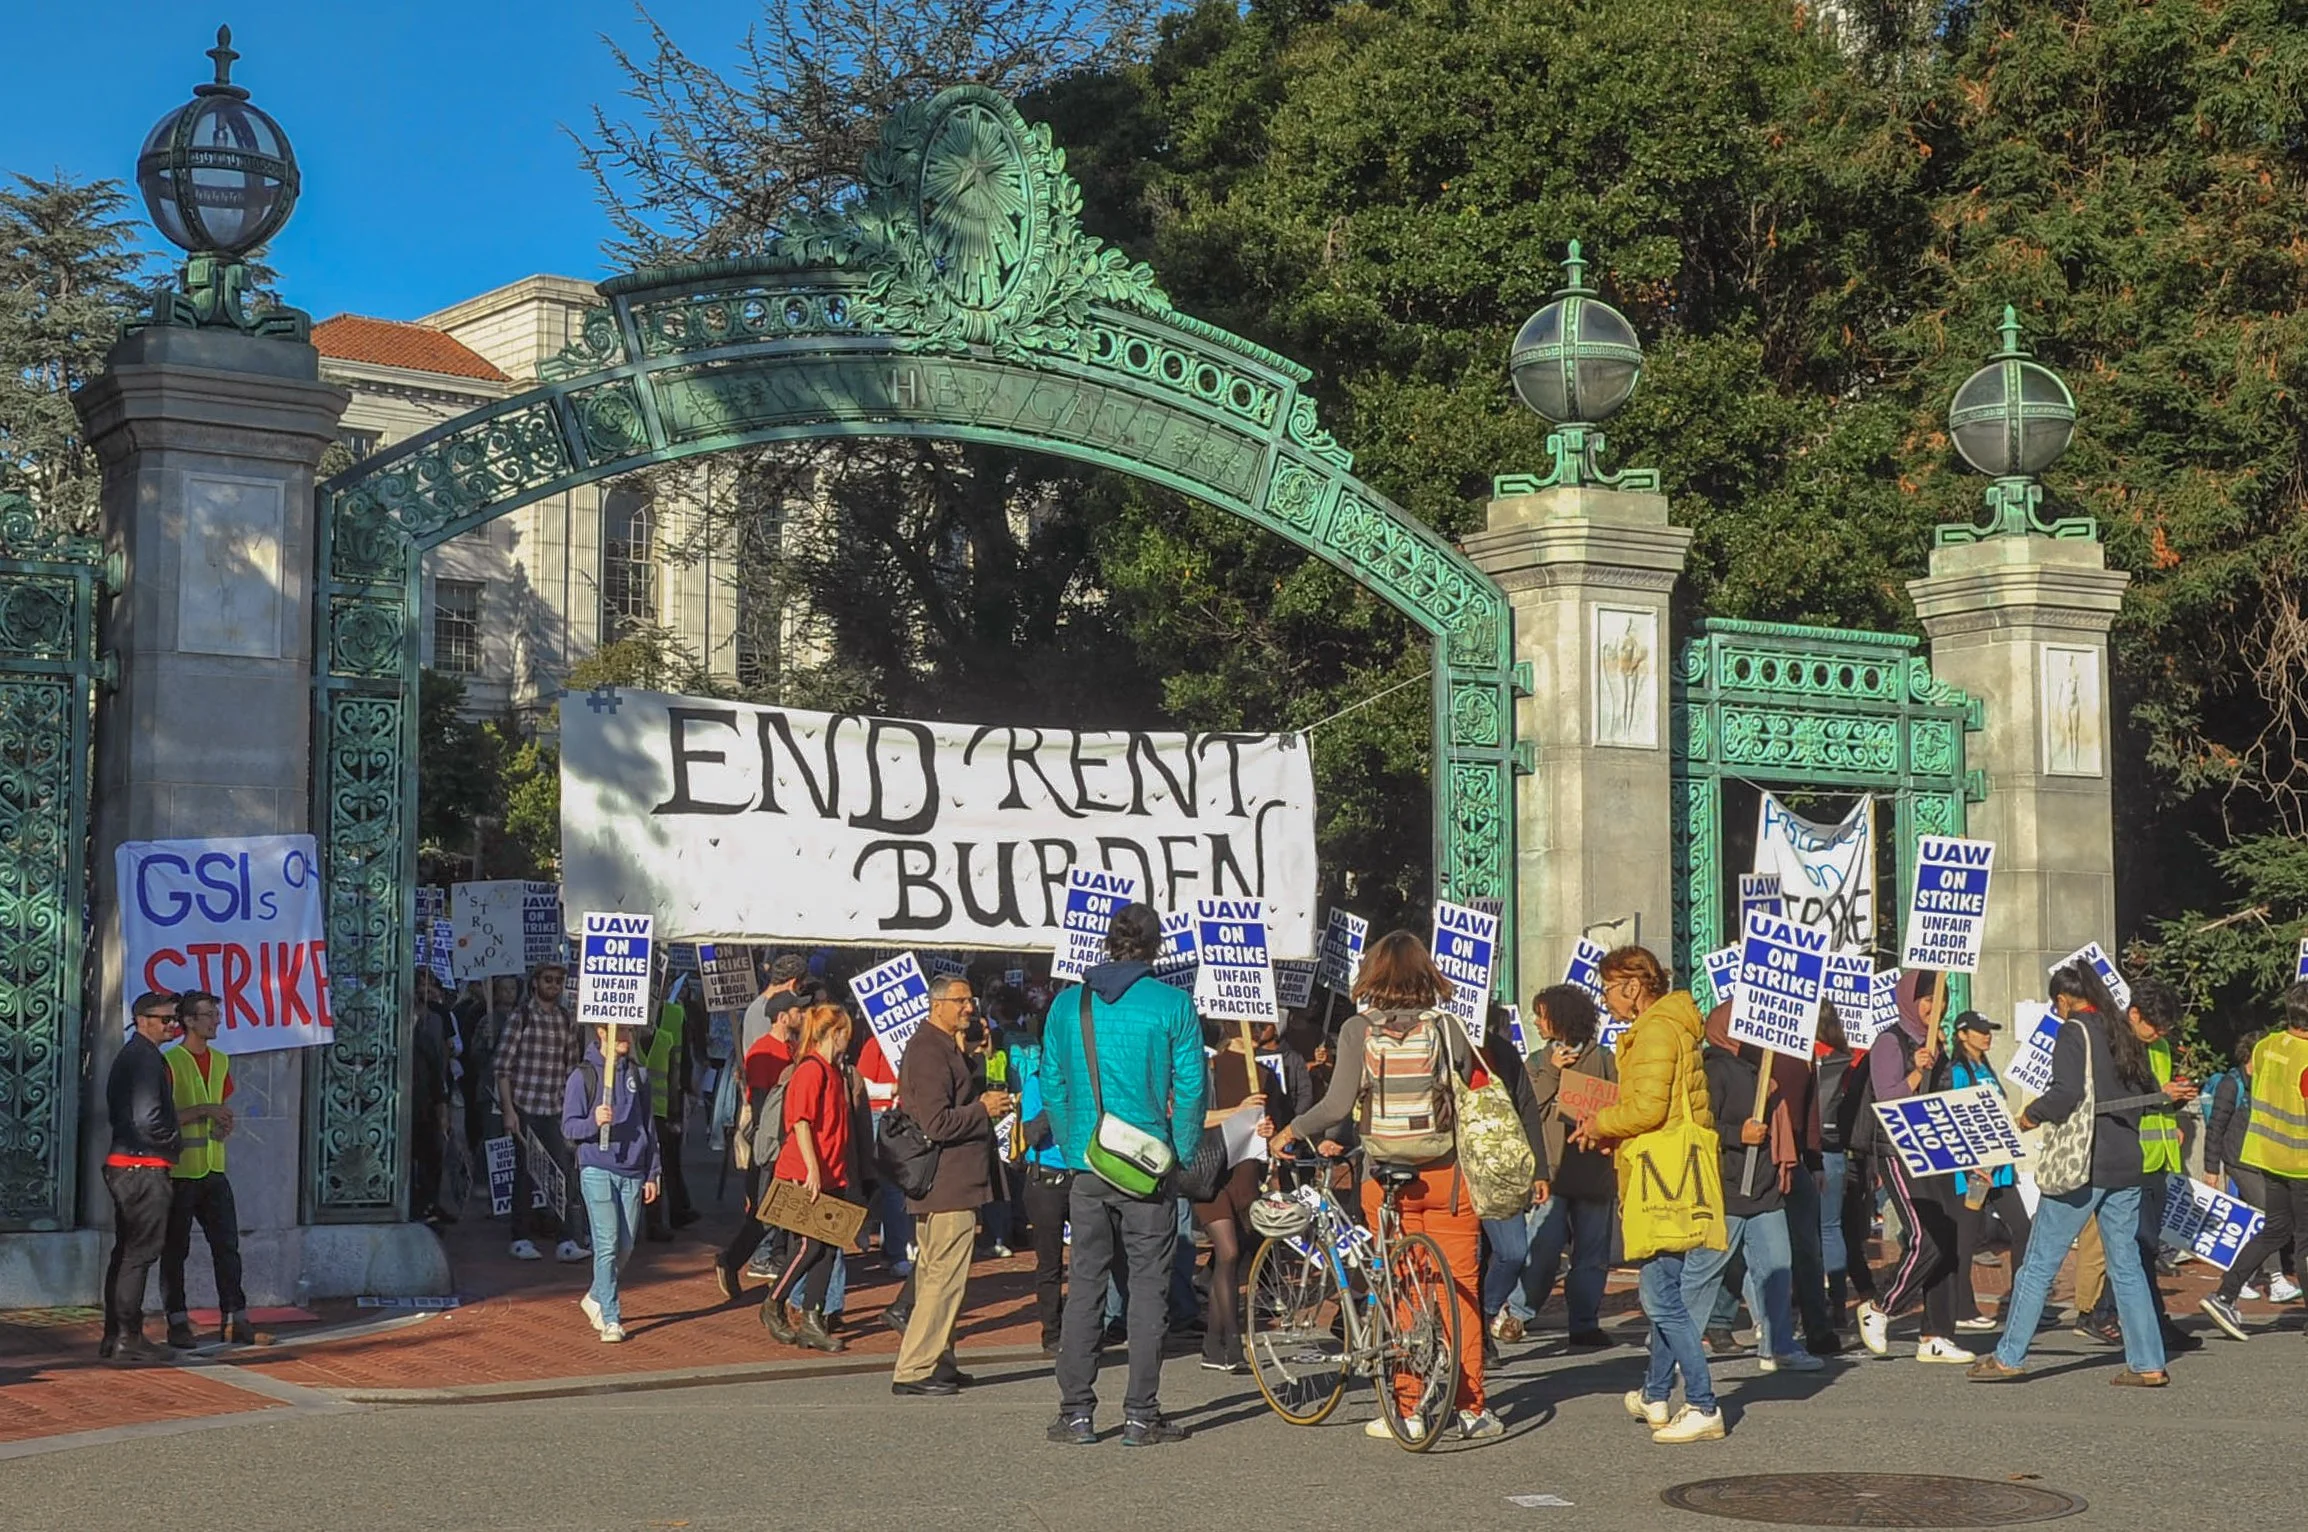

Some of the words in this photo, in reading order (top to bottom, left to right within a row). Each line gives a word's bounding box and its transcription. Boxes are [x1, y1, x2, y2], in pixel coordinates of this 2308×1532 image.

[1028, 387, 1159, 449] GATE
[650, 707, 939, 835] END
[964, 725, 1270, 818] RENT
[1923, 841, 1991, 865] UAW
[853, 800, 1286, 930] BURDEN
[1072, 869, 1135, 895] UAW
[1743, 878, 1780, 896] UAW
[1804, 864, 1844, 891] on
[1939, 870, 1968, 890] ON
[1086, 896, 1112, 914] ON
[1198, 900, 1261, 919] UAW
[1917, 889, 1983, 913] STRIKE
[524, 921, 558, 934] TRIKE
[587, 916, 649, 934] UAW
[1332, 910, 1365, 934] UAW
[1440, 906, 1493, 937] UAW
[1922, 916, 1972, 932] UNFAIR
[1070, 933, 1104, 949] UNFA
[1219, 926, 1244, 943] ON
[1750, 916, 1827, 951] UAW
[1922, 933, 1967, 949] LABOR
[604, 938, 630, 956] ON
[715, 946, 733, 958] ON
[1204, 945, 1267, 964] STRIKE
[1452, 936, 1473, 959] ON
[1578, 942, 1605, 963] UA
[1909, 947, 1976, 966] PRACTICE
[585, 955, 647, 974] STRIKE
[703, 958, 750, 973] STRIKE
[1153, 951, 1197, 976] TRIKE
[1435, 952, 1488, 985] STRIKE
[1708, 951, 1740, 968] UA
[1768, 948, 1798, 972] ON
[592, 977, 638, 990] UNFAIR
[710, 974, 747, 986] UNFAIR
[855, 957, 913, 995] UAW
[1214, 969, 1261, 984] UNFAIR
[1743, 962, 1817, 999] STRIKE
[1832, 975, 1854, 989] ON
[144, 940, 334, 1037] STRIKE
[593, 991, 635, 1004] LABOR
[714, 986, 747, 996] LABOR
[882, 984, 908, 1007] ON
[1217, 985, 1260, 998] LABOR
[1453, 985, 1478, 1004] FAIR
[1825, 988, 1869, 1007] TRIKE
[582, 1004, 645, 1018] PRACTICE
[874, 993, 930, 1031] STRIKE
[1210, 999, 1273, 1015] PRACTICE
[1748, 988, 1804, 1017] UNFAIR
[1838, 1007, 1862, 1020] FAIR
[1748, 1005, 1799, 1033] LABOR
[1734, 1018, 1809, 1052] PRACTICE
[1846, 1030, 1868, 1044] TICE
[1922, 1099, 1973, 1166] STRIKE
[1951, 1103, 1989, 1155] UNFAIR
[1968, 1104, 2004, 1150] LABOR
[1977, 1089, 2026, 1158] PRACTICE
[1877, 1107, 1929, 1173] UAW
[1913, 1123, 1942, 1150] ON
[1637, 1144, 1711, 1208] M
[2167, 1191, 2194, 1232] LABOR
[2180, 1196, 2208, 1240] UNFAIR
[2195, 1198, 2233, 1256] STRIKE
[2220, 1222, 2243, 1249] ON
